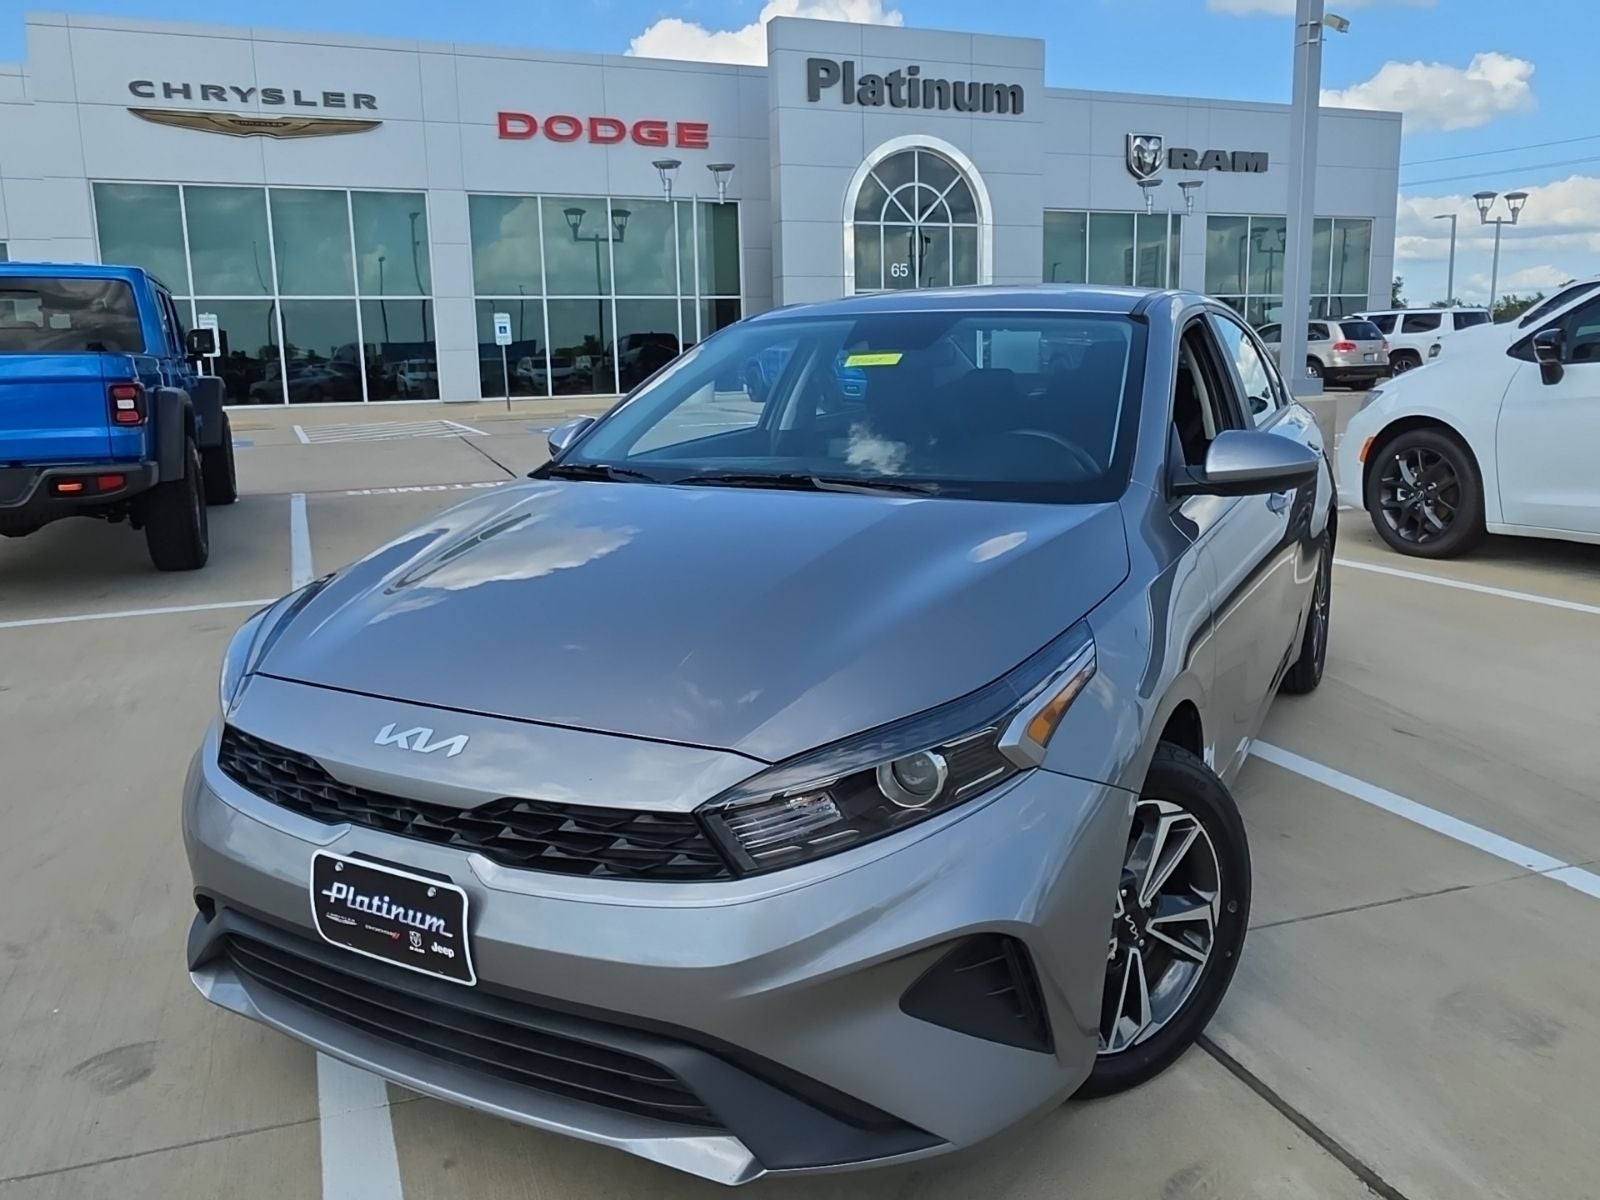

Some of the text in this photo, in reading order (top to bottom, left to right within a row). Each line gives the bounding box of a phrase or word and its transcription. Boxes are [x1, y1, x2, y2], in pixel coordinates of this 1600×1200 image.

[128, 80, 378, 110] CHRYSLER
[807, 57, 1024, 115] Platinum
[497, 112, 709, 149] DODGE
[1168, 148, 1269, 172] RAM
[891, 263, 908, 277] 65
[374, 722, 470, 758] KIA
[321, 881, 453, 938] Platinum
[431, 941, 455, 959] Jeep
